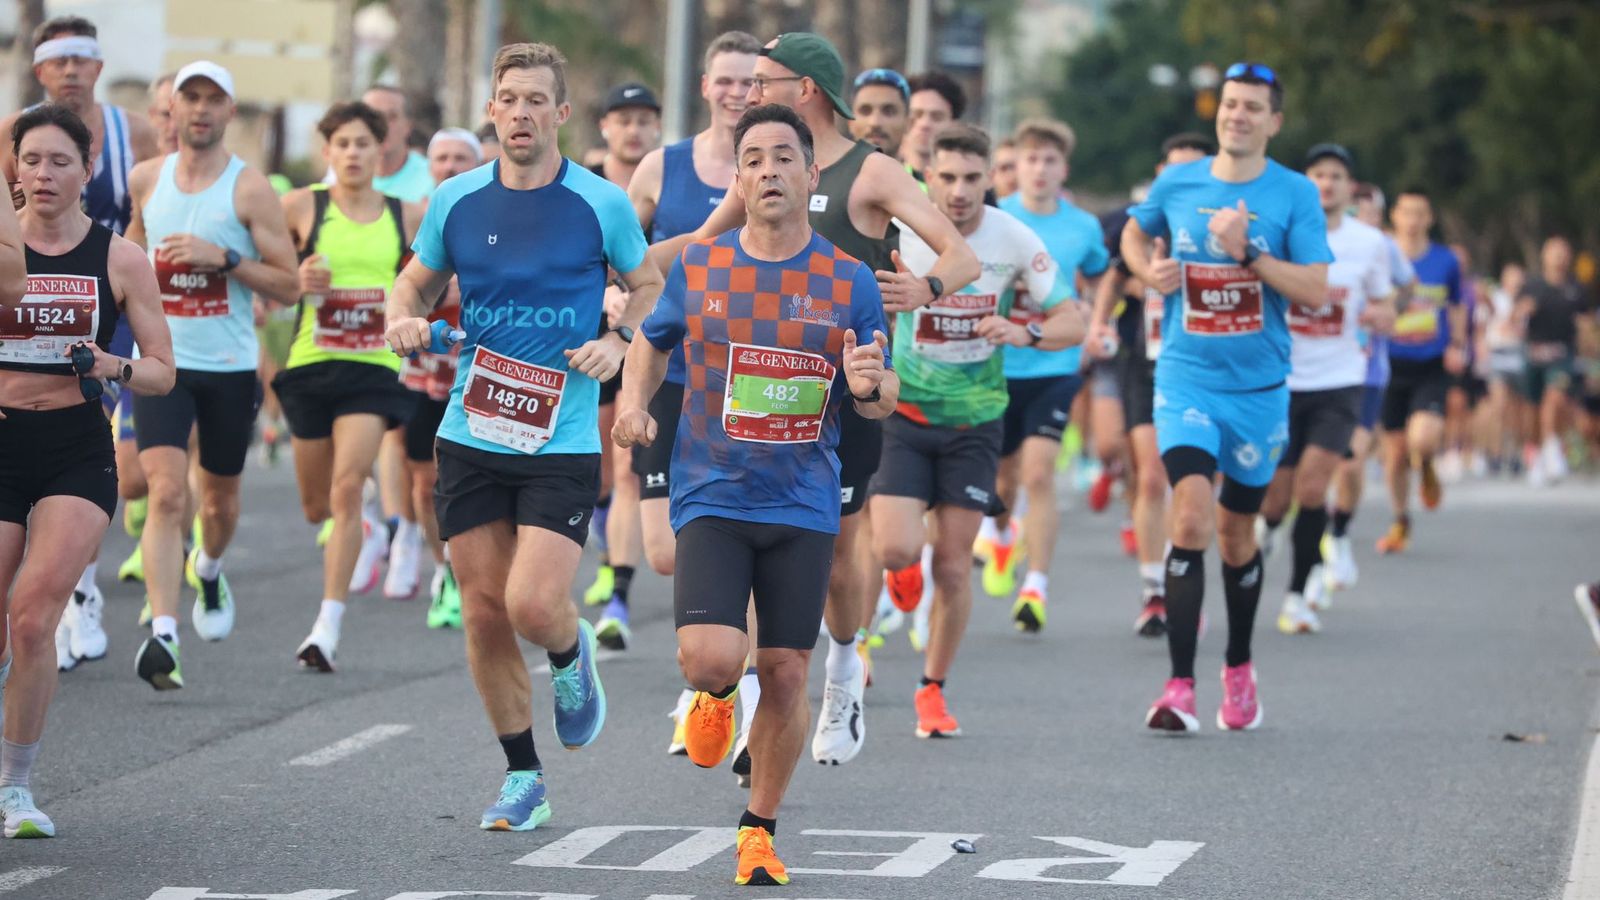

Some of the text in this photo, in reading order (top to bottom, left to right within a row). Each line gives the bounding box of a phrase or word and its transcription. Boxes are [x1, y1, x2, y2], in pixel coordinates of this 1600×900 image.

[170, 273, 208, 288] 4805
[1201, 289, 1241, 305] 6019
[14, 307, 76, 324] 11524
[463, 299, 576, 328] Horizon
[760, 352, 828, 374] GENERALI
[497, 360, 559, 387] GENERALI
[486, 384, 539, 413] 14870
[762, 383, 799, 402] 482
[498, 406, 517, 417] DAVID
[794, 420, 809, 428] 42K
[520, 430, 537, 440] 21K
